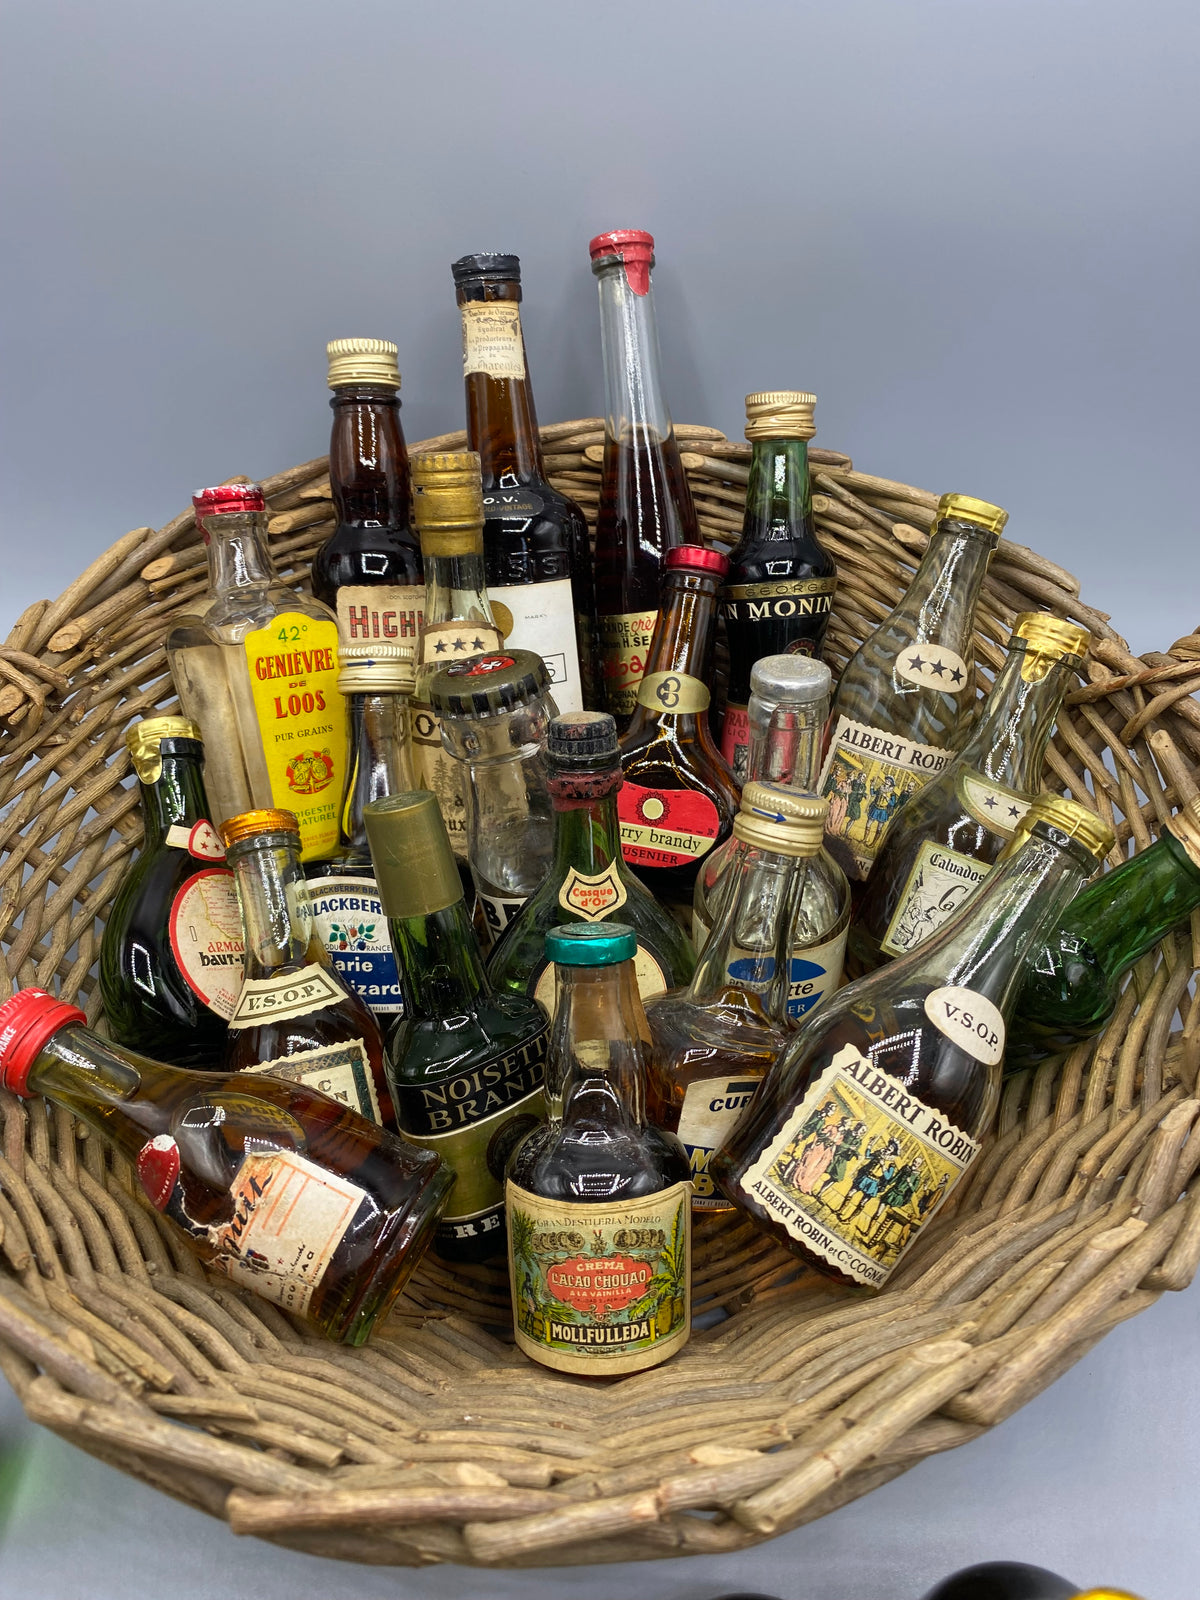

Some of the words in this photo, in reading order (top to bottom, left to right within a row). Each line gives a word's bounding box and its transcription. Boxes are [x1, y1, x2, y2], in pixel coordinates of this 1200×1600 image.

[747, 596, 833, 619] MONIN
[278, 625, 308, 642] 42°
[622, 635, 650, 649] H.SE
[256, 647, 335, 681] GENIÈVRE
[289, 680, 307, 688] DE
[274, 690, 326, 719] LOOS
[275, 732, 294, 742] PUR
[297, 724, 334, 738] GRAINS
[839, 727, 907, 761] ALBERT
[910, 749, 952, 771] ROBI
[299, 811, 337, 826] ATUREL
[620, 827, 643, 843] rry
[649, 829, 702, 853] brandy
[622, 846, 678, 865] USENIER
[929, 852, 985, 883] Calvados
[572, 888, 613, 898] Casque
[313, 898, 382, 917] LACKBER
[366, 944, 391, 952] RANCE
[248, 984, 321, 1012] V.S.O.P.
[944, 1001, 999, 1052] V.S.O.P.
[842, 1060, 926, 1124] ALBERT
[923, 1117, 976, 1164] ROBIN
[537, 1218, 562, 1227] GRAN
[752, 1180, 796, 1218] ALBERT
[792, 1215, 833, 1250] ROBIN
[576, 1261, 625, 1272] CREMA
[551, 1272, 591, 1288] CACAO
[594, 1269, 646, 1289] CHOUAO
[551, 1321, 650, 1344] MOLLFULLEDA
